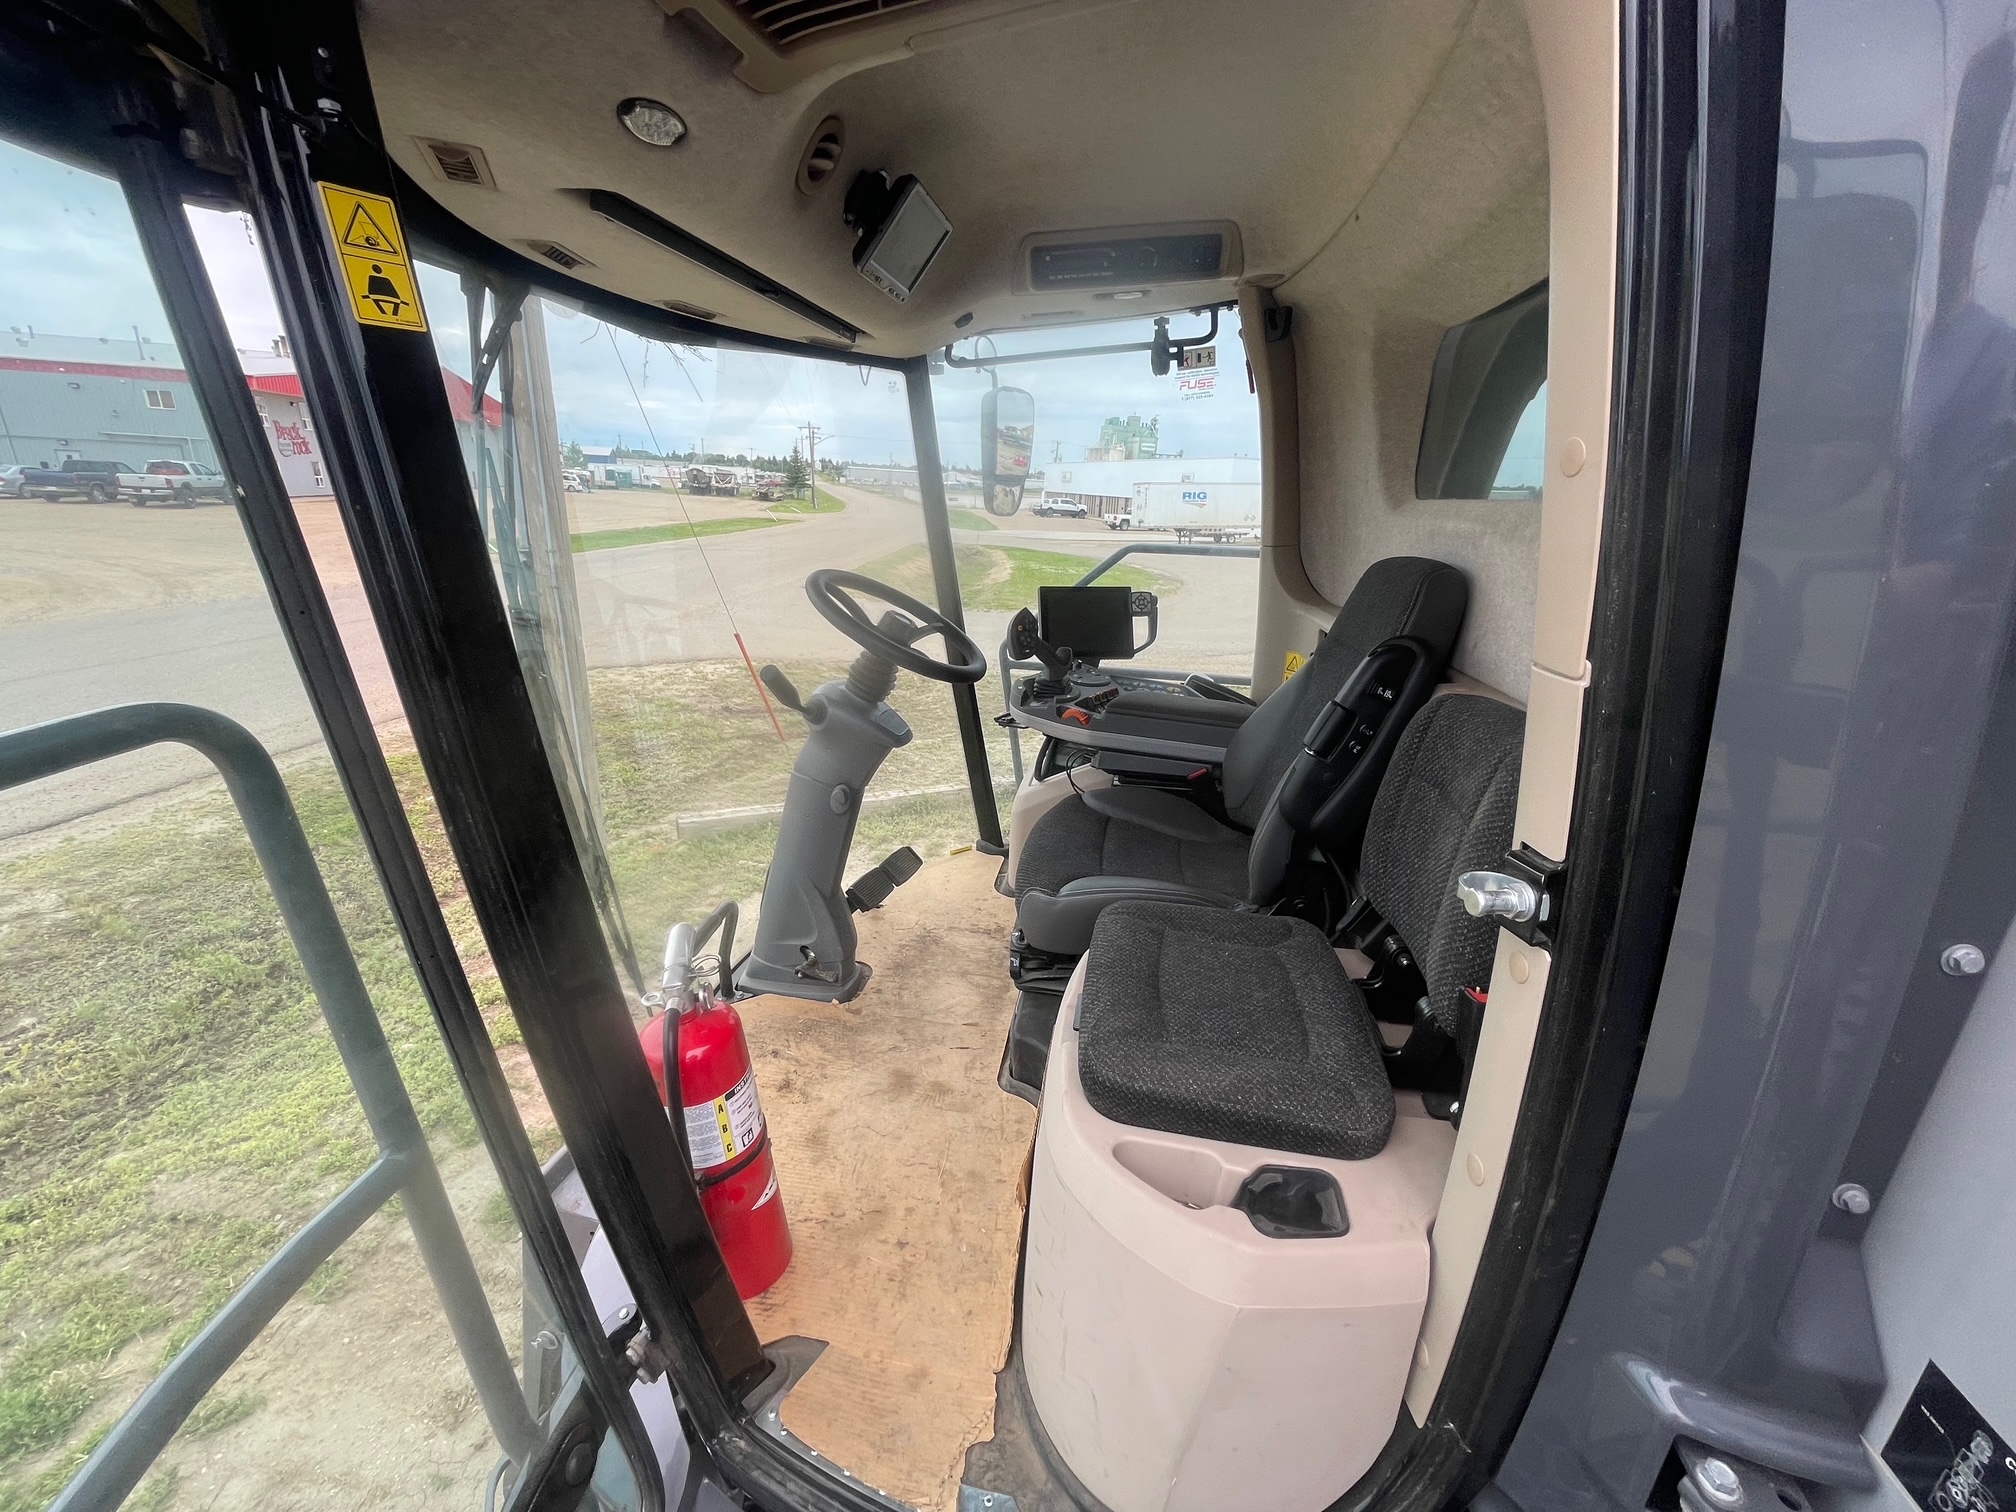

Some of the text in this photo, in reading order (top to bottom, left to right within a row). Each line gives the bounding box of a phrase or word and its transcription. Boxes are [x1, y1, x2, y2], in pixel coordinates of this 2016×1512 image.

[1180, 378, 1214, 390] FUSE
[1183, 491, 1207, 499] RIG
[718, 1104, 724, 1113] A
[722, 1123, 728, 1133] B
[726, 1143, 733, 1153] C
